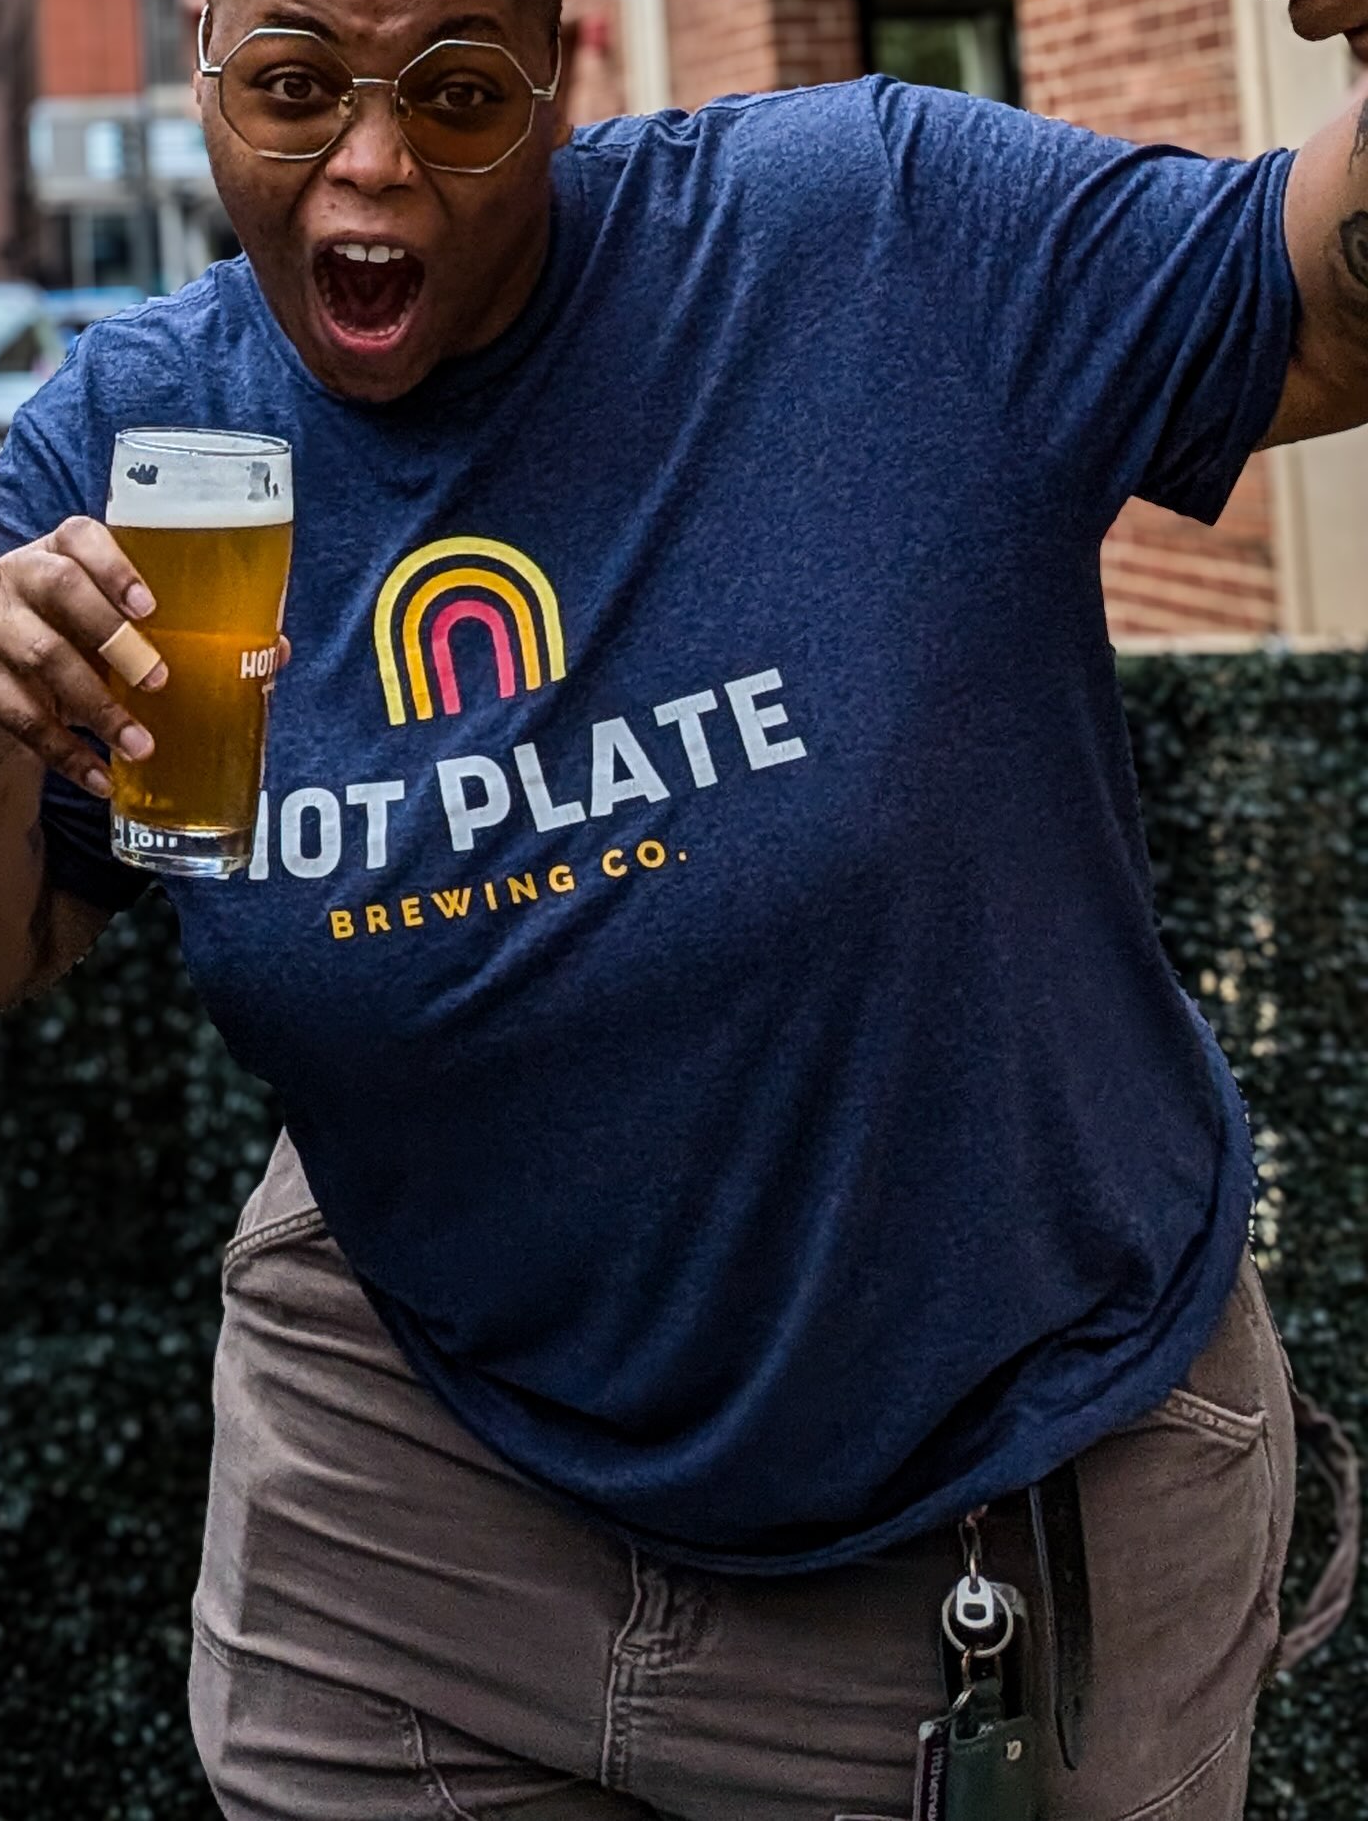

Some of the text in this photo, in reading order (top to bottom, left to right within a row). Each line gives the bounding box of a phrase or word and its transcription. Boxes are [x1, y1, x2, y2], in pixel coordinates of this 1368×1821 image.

[240, 647, 277, 679] HOT
[436, 668, 807, 852] PLATE
[329, 839, 688, 940] BREWING CO.
